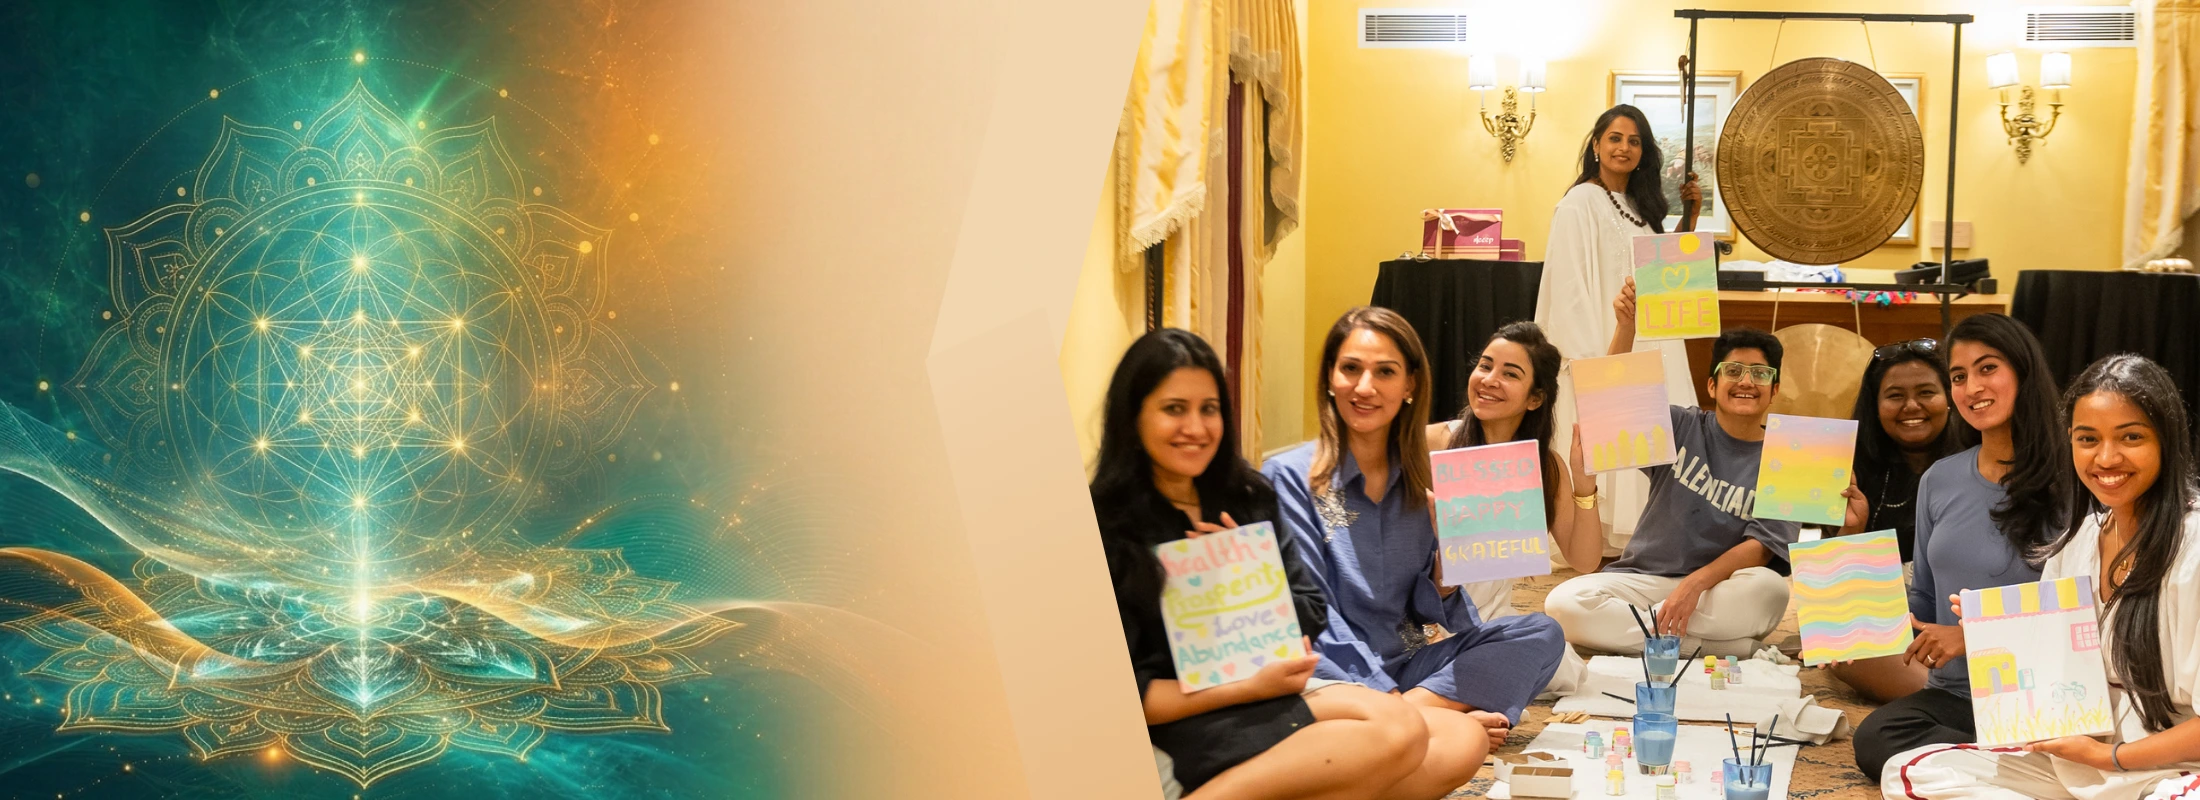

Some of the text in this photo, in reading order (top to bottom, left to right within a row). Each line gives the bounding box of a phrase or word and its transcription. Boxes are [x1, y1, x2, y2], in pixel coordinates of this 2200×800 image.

[1651, 238, 1669, 265] I
[1645, 297, 1712, 329] LIFE
[1436, 457, 1535, 483] BLESSED
[1441, 500, 1525, 527] HAPPY
[1160, 535, 1258, 577] health
[1213, 609, 1276, 638] Love
[1177, 622, 1302, 671] Abundance
